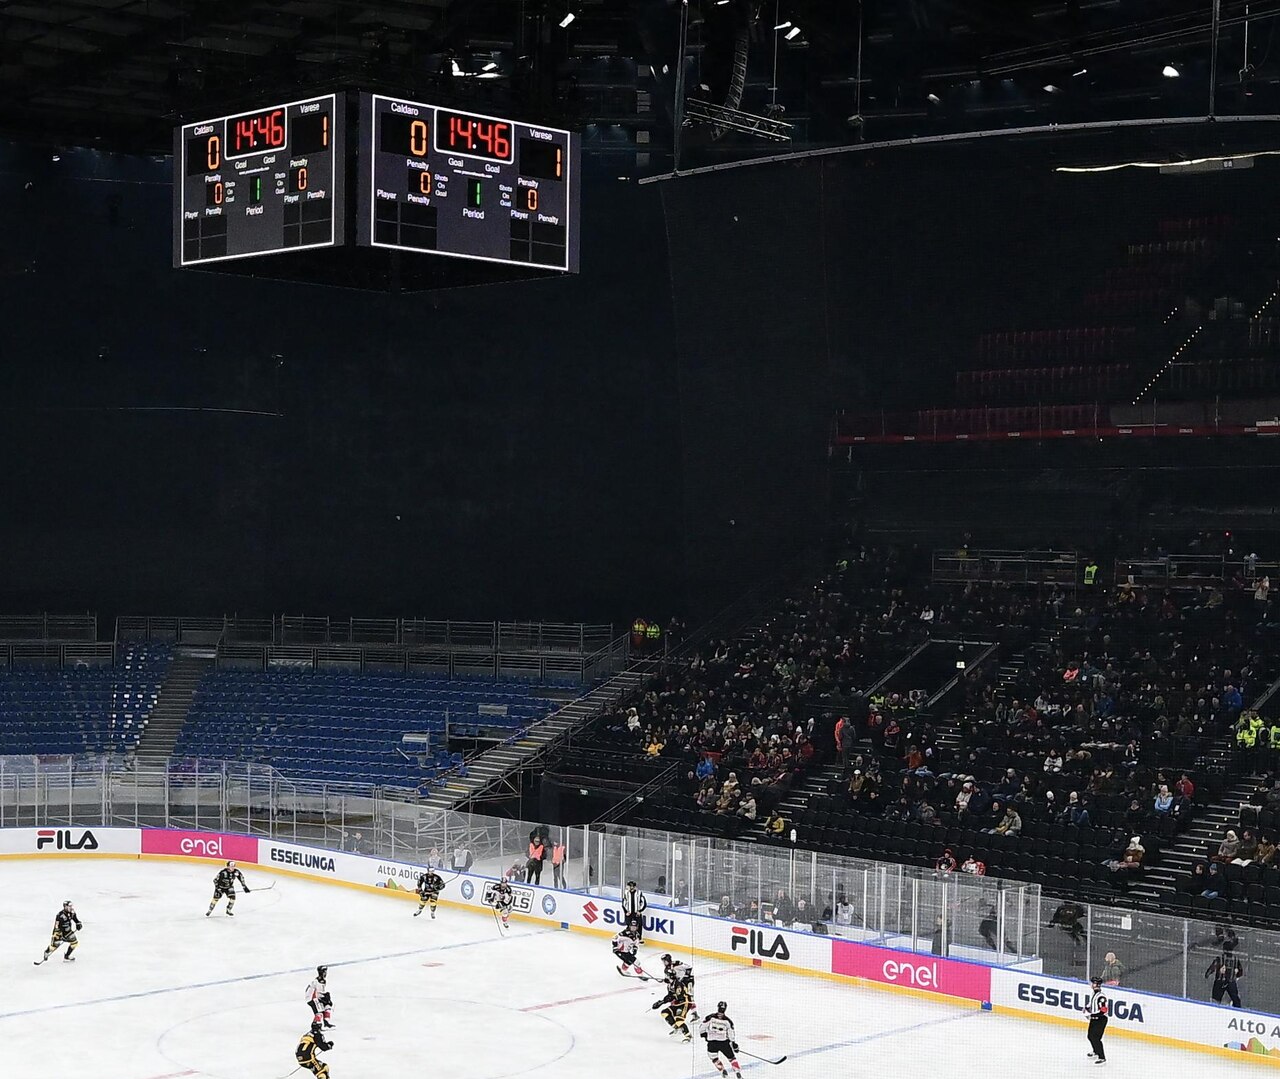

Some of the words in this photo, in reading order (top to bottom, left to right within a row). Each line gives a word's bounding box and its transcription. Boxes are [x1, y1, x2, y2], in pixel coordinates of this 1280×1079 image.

[300, 103, 320, 114] Varese
[391, 103, 419, 116] Caldaro
[194, 125, 214, 135] Caldaro
[236, 111, 284, 150] 14:46
[323, 116, 328, 146] 1
[411, 121, 426, 157] 0
[450, 117, 508, 158] 14:46
[529, 128, 552, 141] Varese
[208, 136, 219, 170] 0
[448, 158, 464, 168] Goal
[556, 148, 561, 177] 1
[407, 159, 429, 172] Penalty
[485, 163, 500, 174] Goal
[298, 168, 307, 190] 0
[421, 171, 431, 194] 0
[518, 177, 539, 189] Penalty
[215, 183, 222, 204] 0
[377, 189, 397, 200] Player
[408, 194, 430, 206] Penalty
[528, 189, 537, 210] 0
[246, 205, 263, 215] Period
[463, 208, 484, 220] Period
[511, 210, 528, 221] Player
[538, 213, 559, 225] Penalty
[37, 830, 98, 850] FILA
[180, 836, 223, 856] enel
[271, 848, 336, 873] ESSELUNGA
[603, 908, 674, 935] SUUKI
[731, 926, 790, 961] FILA
[882, 960, 938, 988] enel
